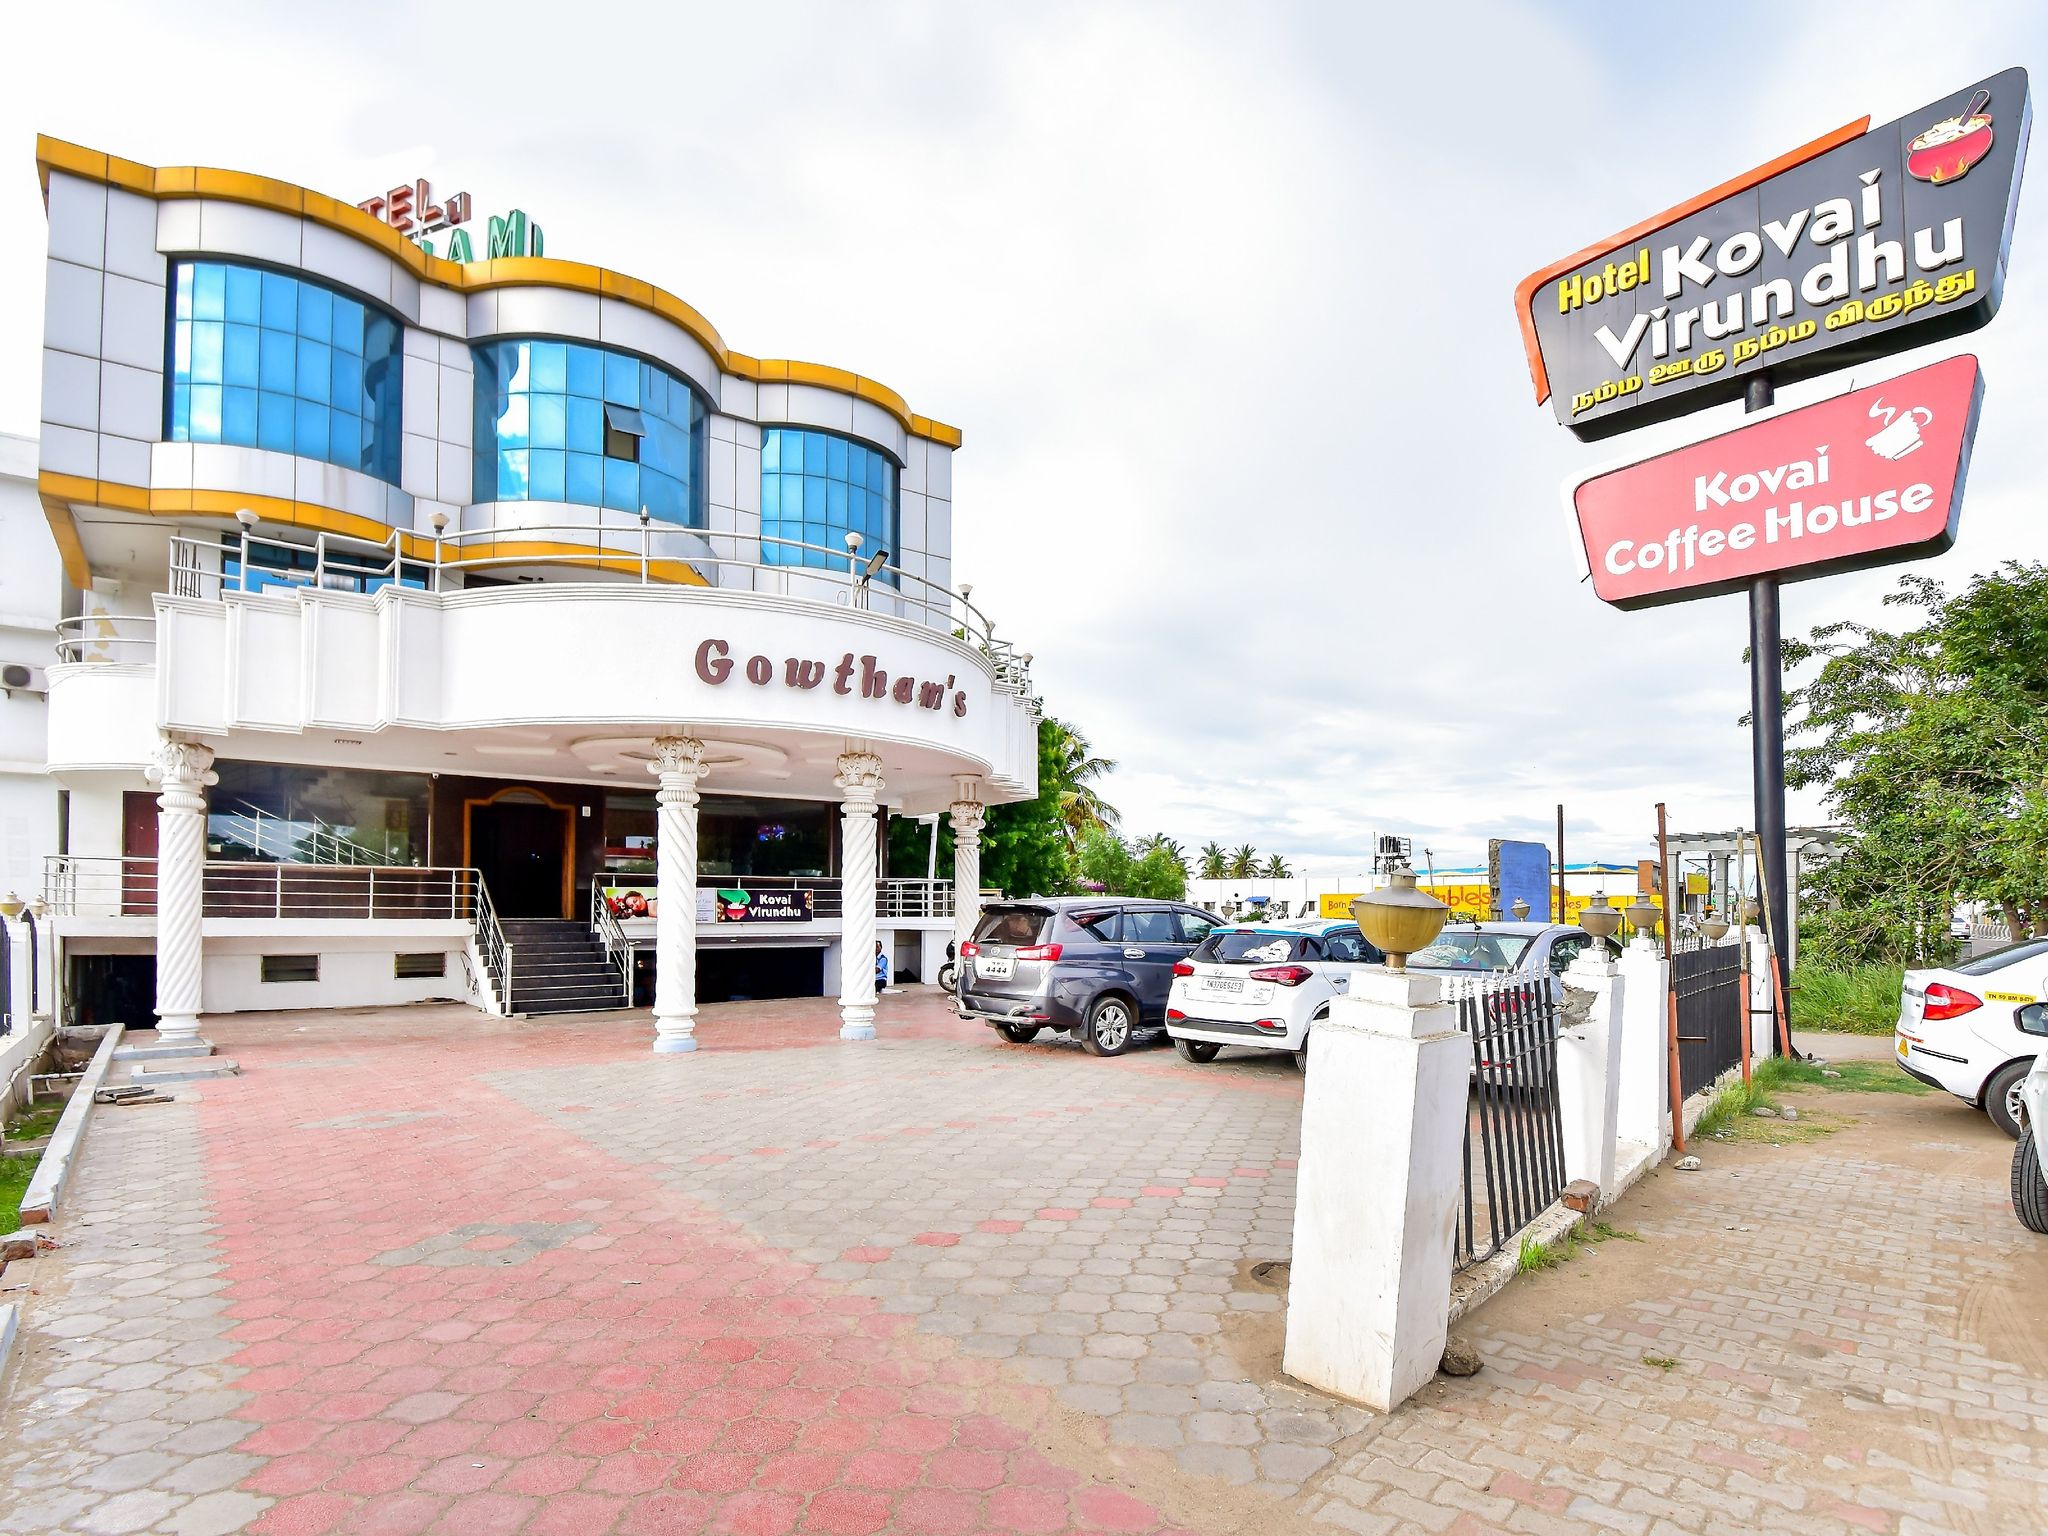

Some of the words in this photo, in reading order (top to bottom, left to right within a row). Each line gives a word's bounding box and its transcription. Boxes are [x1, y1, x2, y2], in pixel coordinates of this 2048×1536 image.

[1558, 248, 1651, 314] Hotel
[1661, 168, 1882, 300] Kovai
[1594, 217, 1964, 371] Virundhu
[1571, 376, 1643, 417] நம்ம
[1648, 348, 1727, 386] ஊரு
[1732, 319, 1817, 368] நம்ம
[1824, 268, 1976, 331] விருந்து
[1694, 444, 1831, 512] Kovai
[1604, 520, 1756, 575] Coffee
[1764, 481, 1934, 545] House
[694, 638, 968, 718] Gowtham's
[749, 906, 801, 918] Virundhu
[759, 894, 792, 905] Kovai
[1328, 900, 1347, 911] Born
